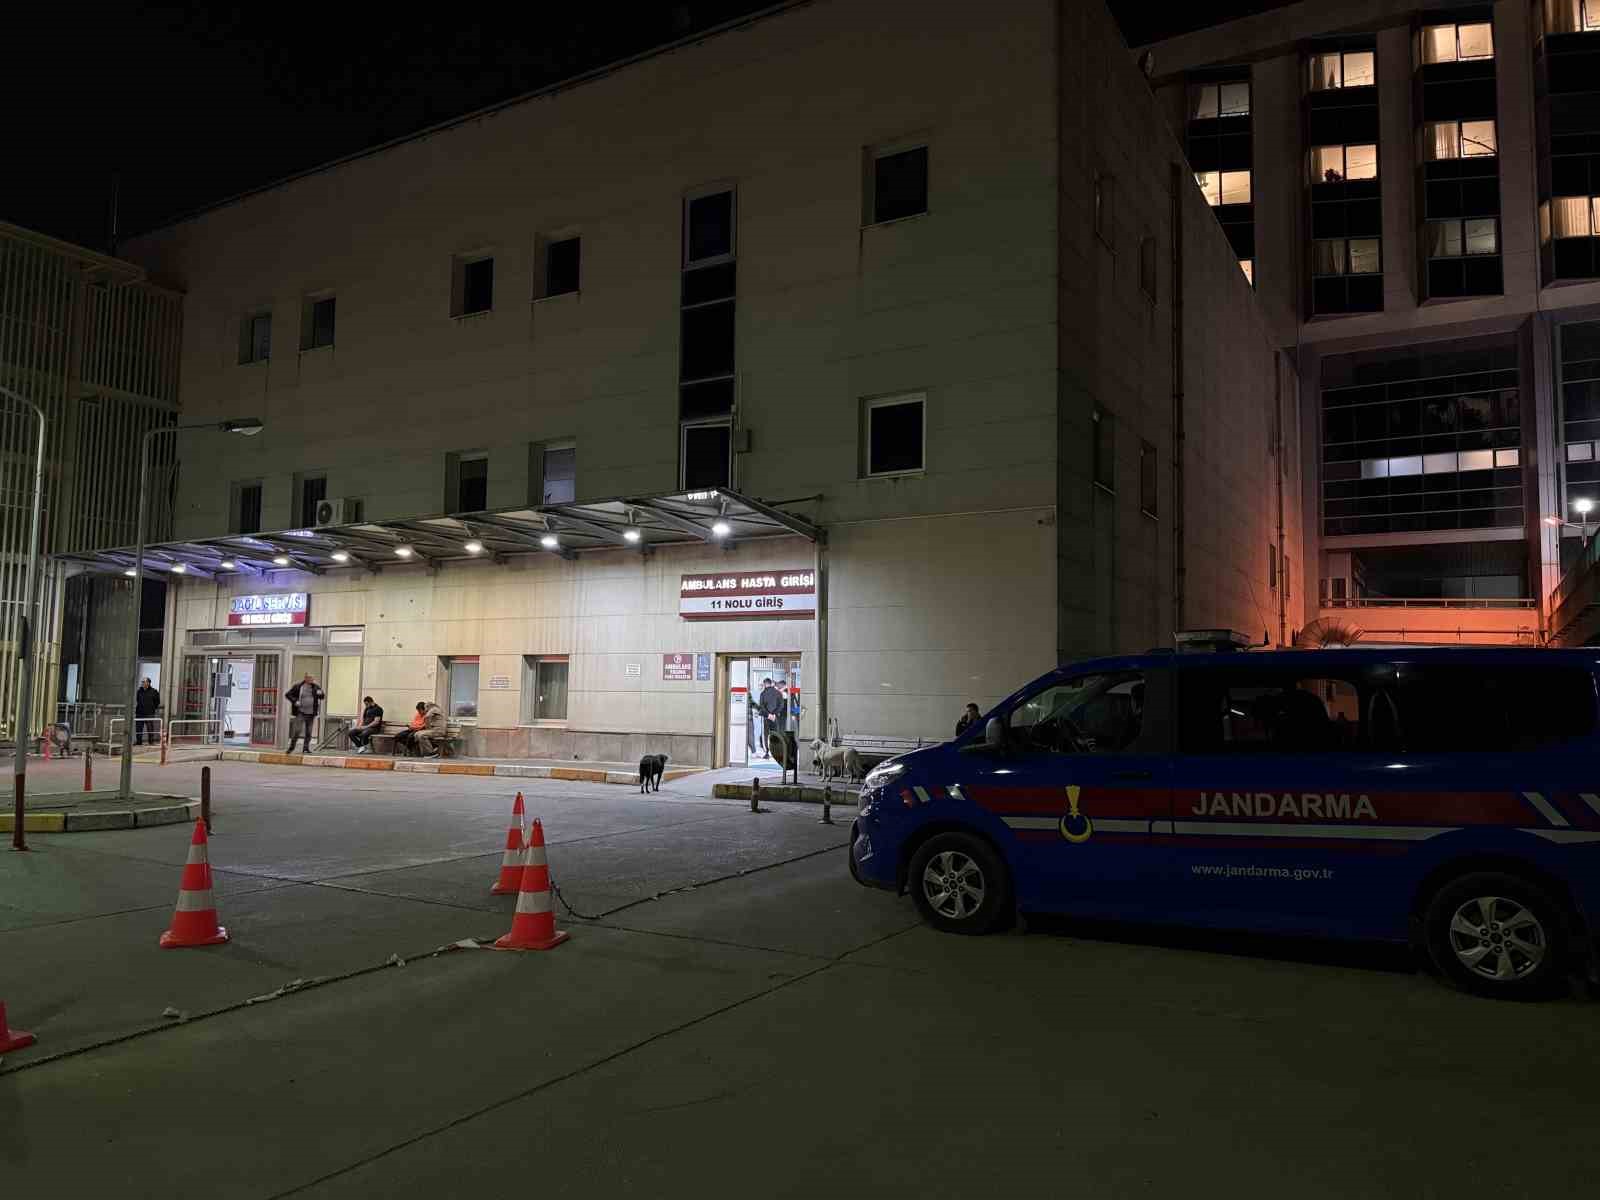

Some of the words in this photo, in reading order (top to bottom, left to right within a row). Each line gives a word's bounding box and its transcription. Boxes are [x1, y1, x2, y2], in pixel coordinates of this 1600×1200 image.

[681, 579, 737, 591] AMBULANS
[741, 577, 776, 588] HASTA
[711, 601, 722, 609] 11
[725, 600, 752, 609] NOLU
[755, 597, 784, 608] GİRİŞ
[1191, 791, 1378, 819] JANDARMA
[1191, 864, 1335, 880] www.jandarma.gov.tr
